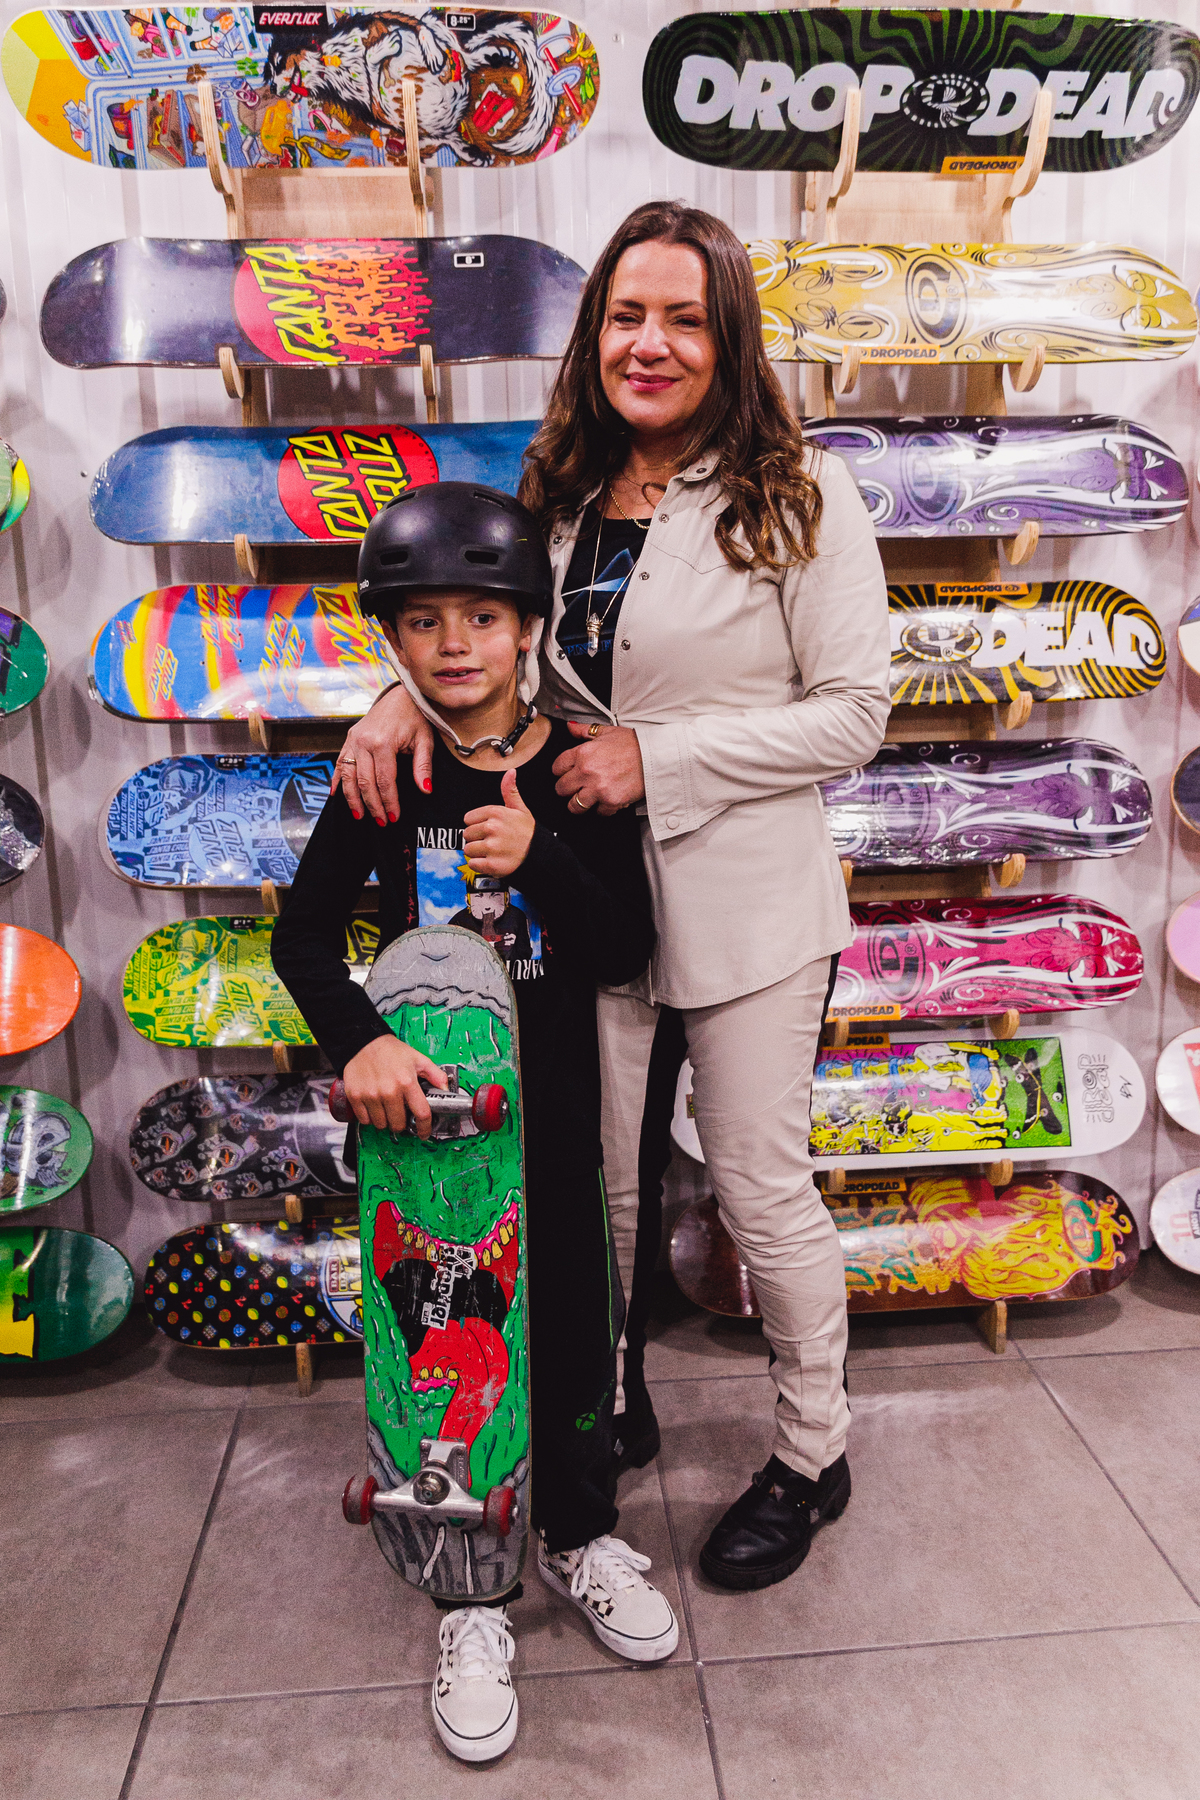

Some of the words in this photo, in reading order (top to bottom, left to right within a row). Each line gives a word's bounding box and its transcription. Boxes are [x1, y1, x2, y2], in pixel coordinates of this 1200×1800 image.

[258, 12, 323, 26] EVERSLICK
[674, 55, 915, 133] DROP
[967, 66, 1187, 142] DEAD
[949, 160, 1017, 171] DROPDEAD
[870, 348, 937, 358] DROPDEAD
[342, 432, 408, 511] RUZ
[940, 585, 1002, 593] DROPDEAD
[971, 611, 1153, 670] DEAD
[416, 826, 467, 850] NARUT
[506, 959, 545, 980] NARU
[833, 1006, 894, 1017] DROPDEAD
[824, 1036, 884, 1047] DPDEAD
